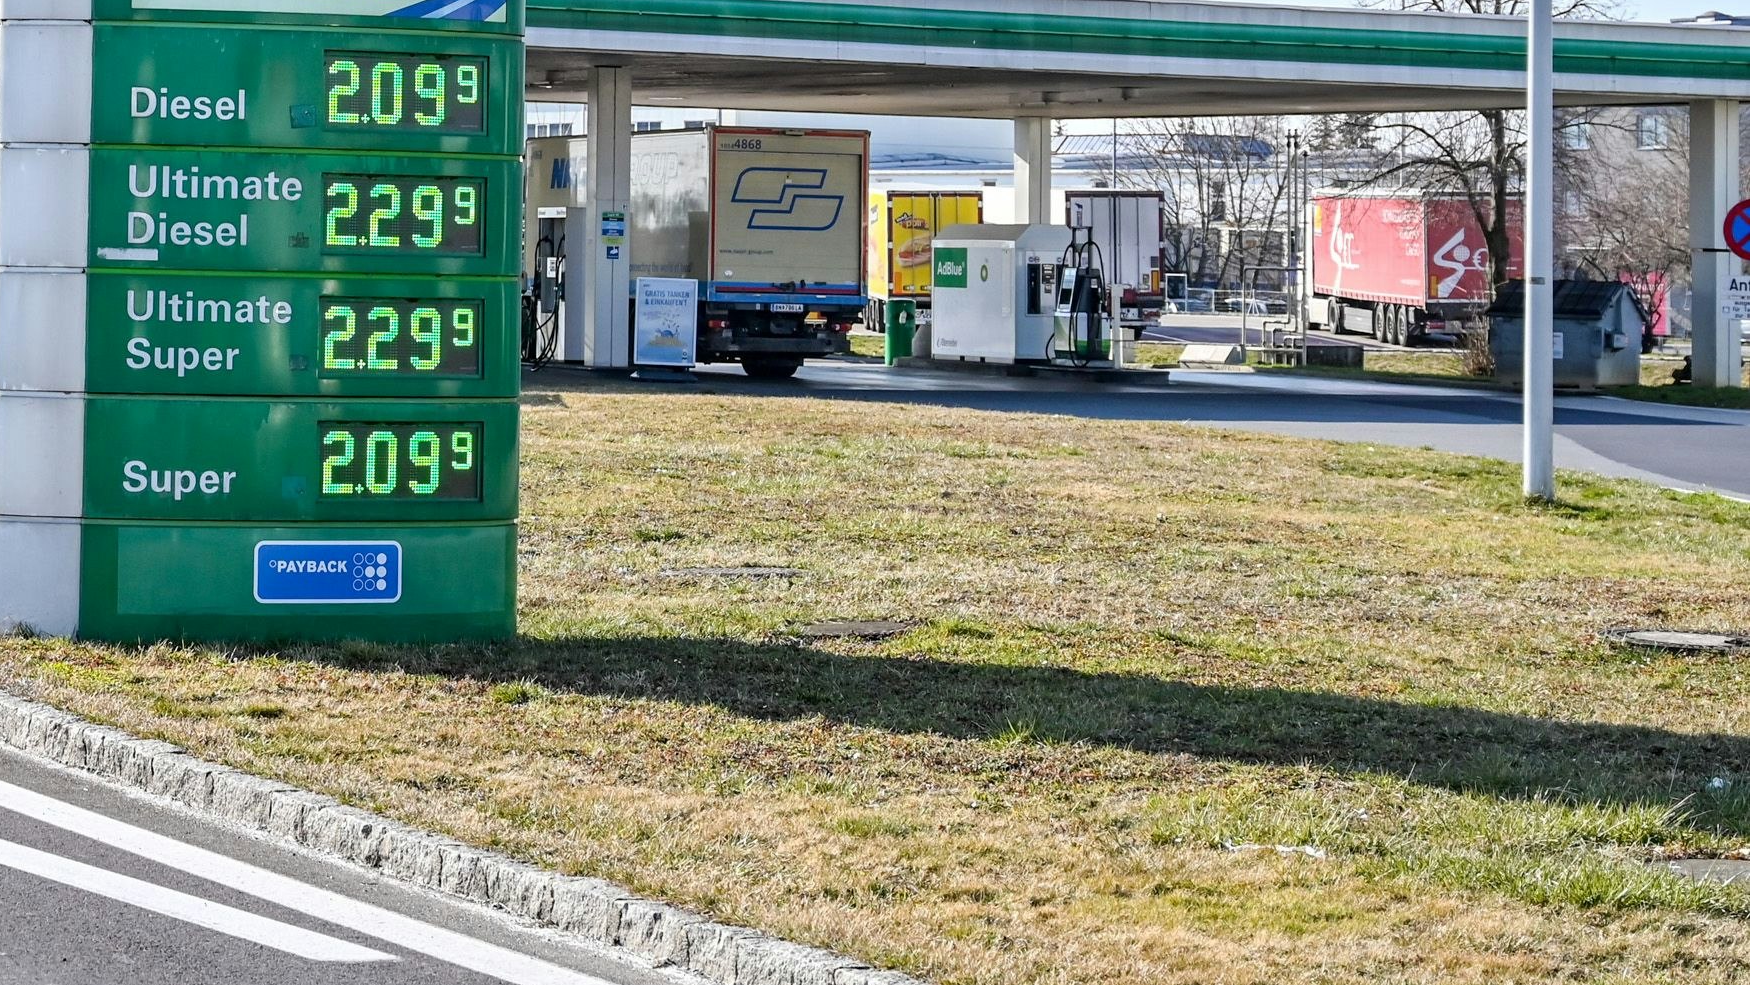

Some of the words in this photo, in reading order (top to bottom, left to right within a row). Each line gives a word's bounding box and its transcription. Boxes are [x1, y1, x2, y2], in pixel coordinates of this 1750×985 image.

[130, 86, 246, 120] Diesel
[128, 165, 302, 201] Ultimate
[127, 211, 248, 246] Diesel
[1730, 278, 1750, 291] An
[126, 290, 292, 324] Ultimate
[125, 337, 240, 377] Super
[122, 460, 236, 501] Super
